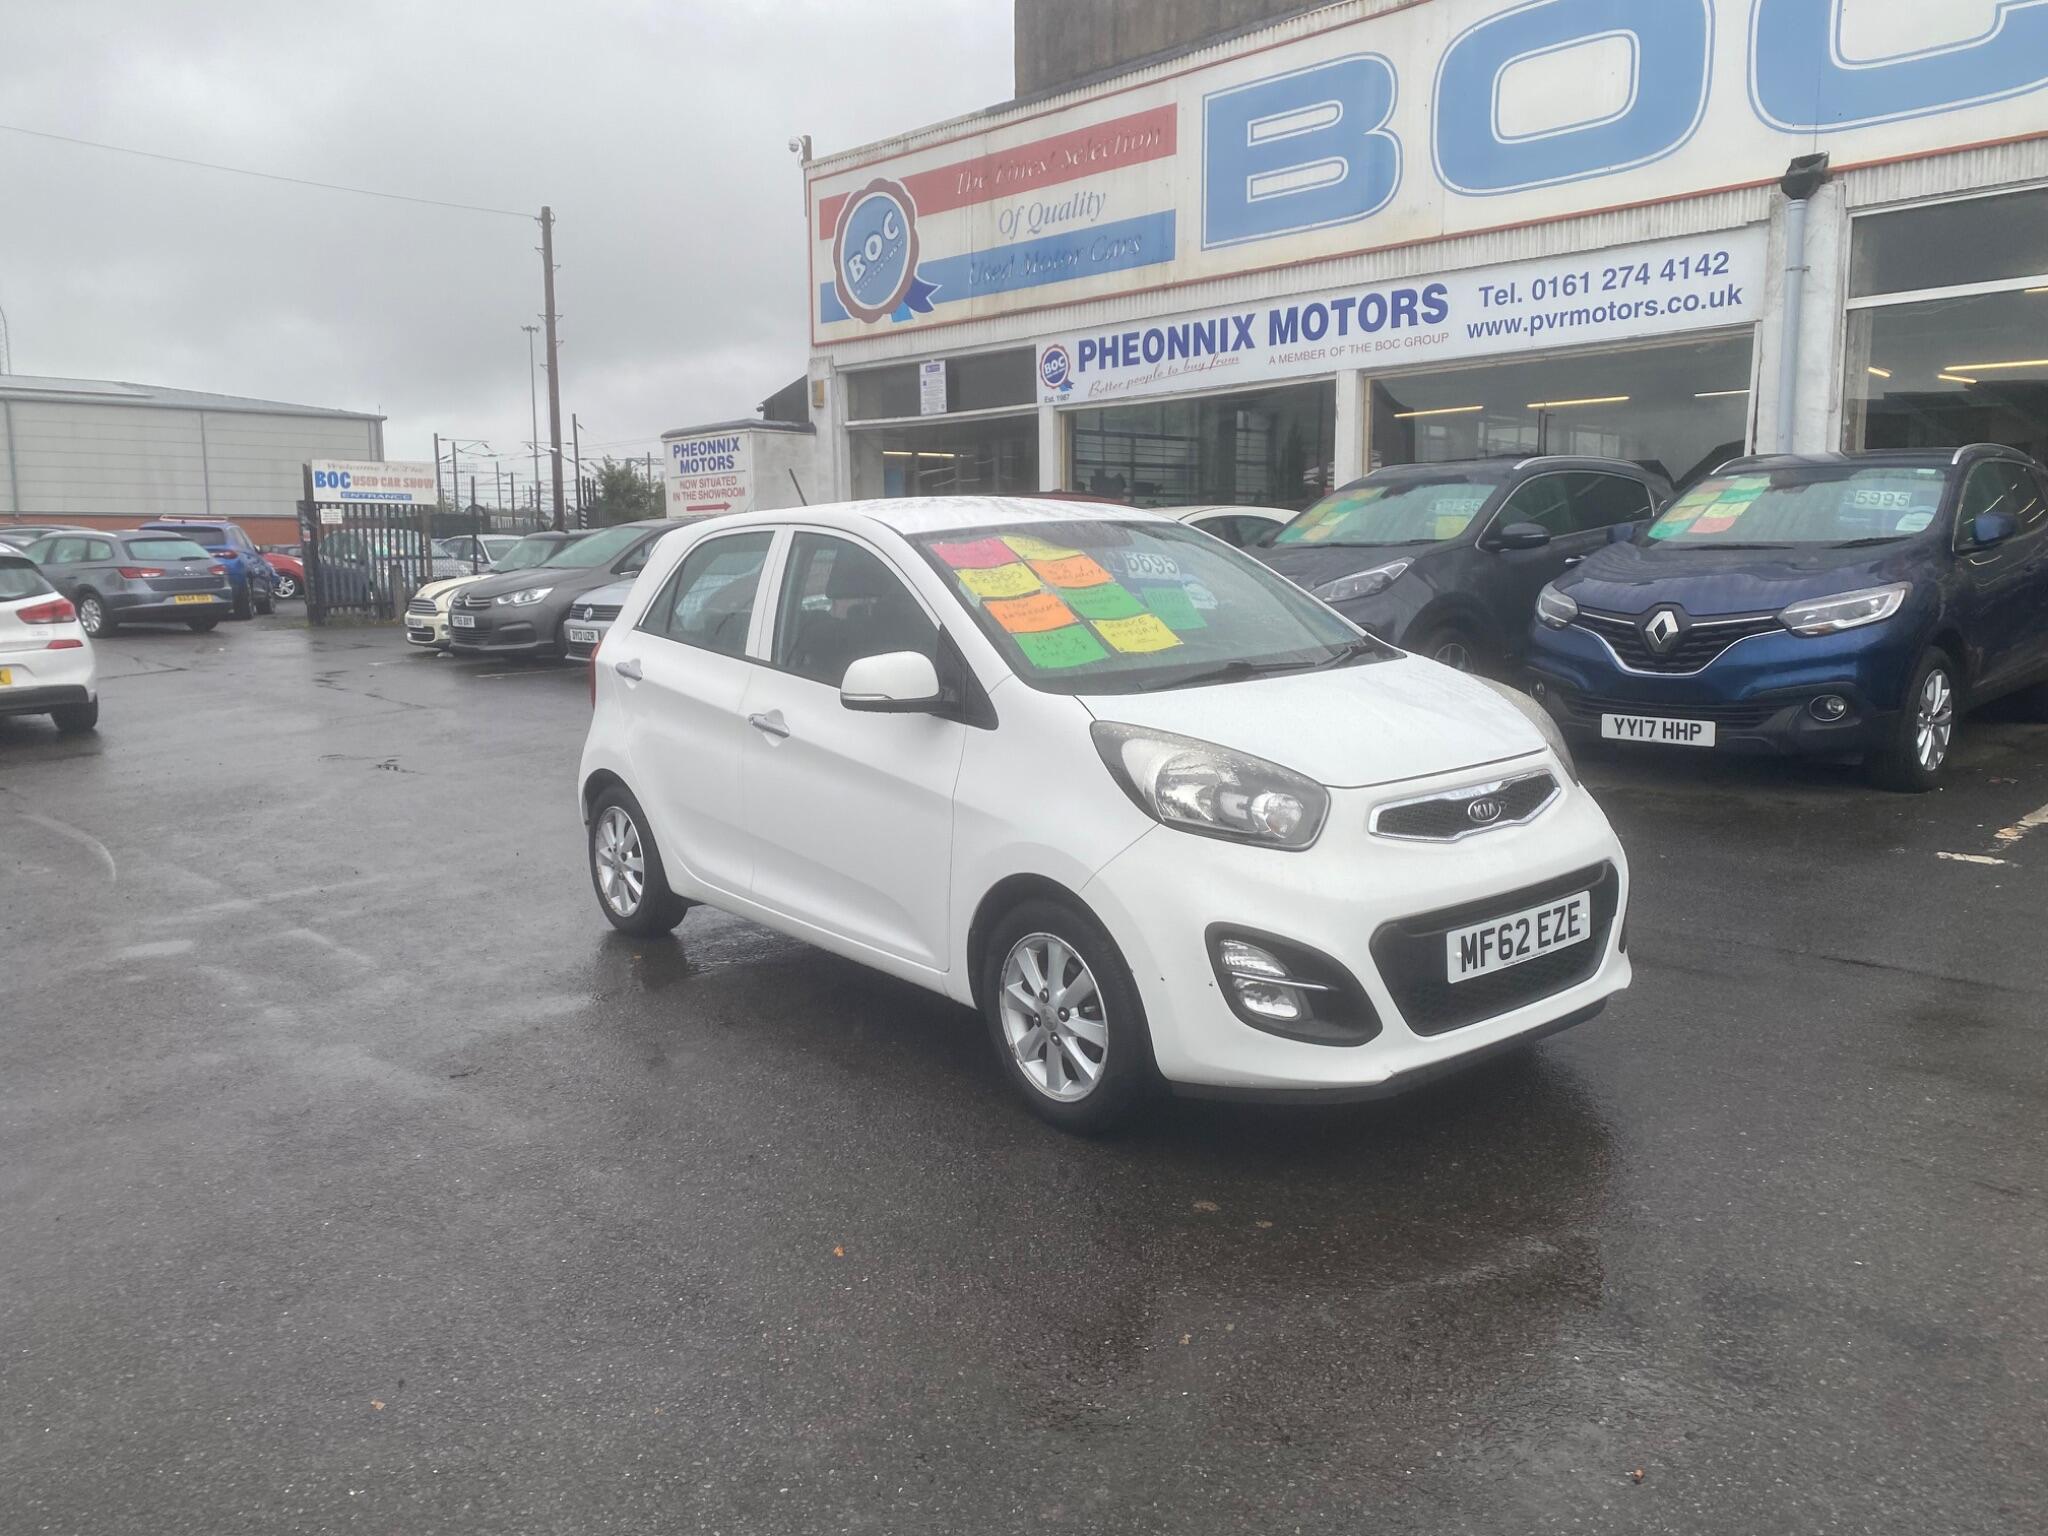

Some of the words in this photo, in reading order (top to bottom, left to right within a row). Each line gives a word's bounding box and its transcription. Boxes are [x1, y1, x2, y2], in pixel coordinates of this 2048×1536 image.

[999, 205, 1025, 240] Of
[1027, 192, 1107, 235] Quality
[847, 208, 899, 283] BOC
[969, 252, 1016, 286] Used
[1021, 245, 1084, 277] Motor
[1091, 232, 1143, 263] Cars
[1479, 284, 1523, 308] Tel.
[1532, 276, 1591, 302] 0161
[1602, 263, 1651, 292] 274
[1660, 250, 1730, 282] 4142
[1467, 283, 1743, 340] www.pvrmotors.co.uk
[1078, 313, 1256, 373] PHEONNIX
[1268, 282, 1449, 346] MOTORS
[1268, 356, 1277, 366] A
[1279, 349, 1326, 364] MEMBER
[1330, 345, 1346, 358] OF
[1349, 342, 1372, 355] THE
[1375, 338, 1401, 351] BOC
[1404, 332, 1450, 348] GROUP
[1044, 355, 1066, 375] BOC
[1088, 379, 1123, 397] Better
[1126, 363, 1164, 390] people
[1168, 361, 1178, 376] to
[1184, 358, 1204, 374] buy
[1208, 353, 1240, 370] from
[672, 437, 741, 459] PHEONNIX
[680, 455, 735, 474] MOTORS
[314, 471, 351, 489] BOC
[352, 475, 378, 487] USED
[380, 476, 400, 488] CAR
[403, 478, 434, 489] SHOW
[680, 478, 698, 490] NOW
[700, 476, 737, 489] SITUATED
[342, 492, 411, 500] ENTRANCE
[673, 491, 680, 502] IN
[683, 490, 697, 501] THE
[698, 487, 746, 501] SHOWROOM
[1855, 492, 1910, 507] 5995
[1614, 717, 1657, 738] YY17
[1662, 721, 1702, 741] HHP
[1473, 802, 1496, 819] KIA
[1460, 918, 1531, 973] MF62
[1537, 900, 1581, 949] EZE
